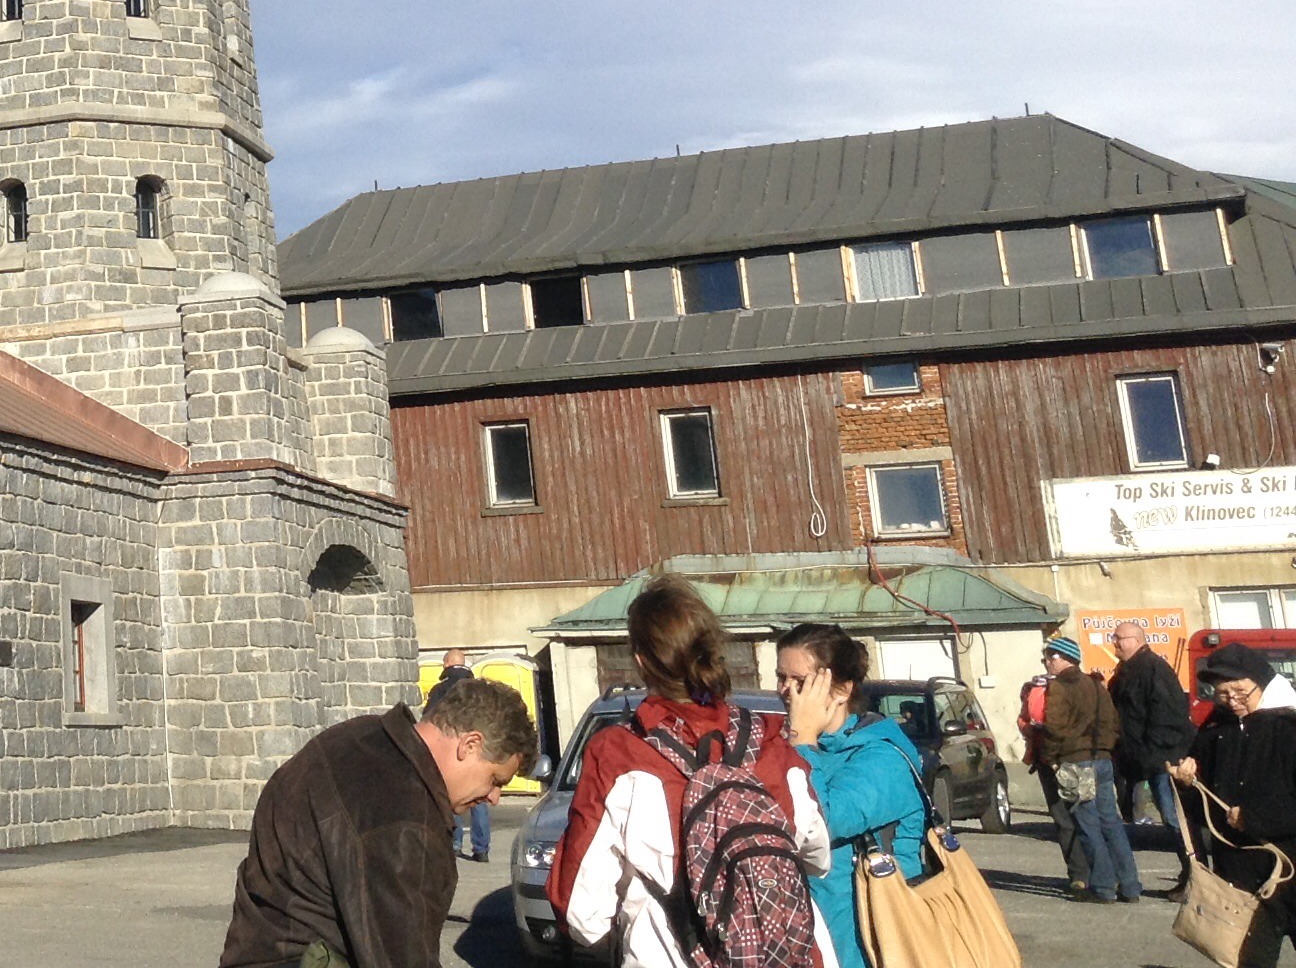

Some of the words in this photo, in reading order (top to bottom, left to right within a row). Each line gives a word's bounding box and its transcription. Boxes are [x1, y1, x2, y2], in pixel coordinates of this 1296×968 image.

[1115, 484, 1142, 503] Top
[1149, 482, 1175, 499] Ski
[1182, 479, 1233, 497] Servis
[1240, 477, 1253, 494] &
[1260, 475, 1286, 493] Ski
[1184, 505, 1255, 522] Klínovec
